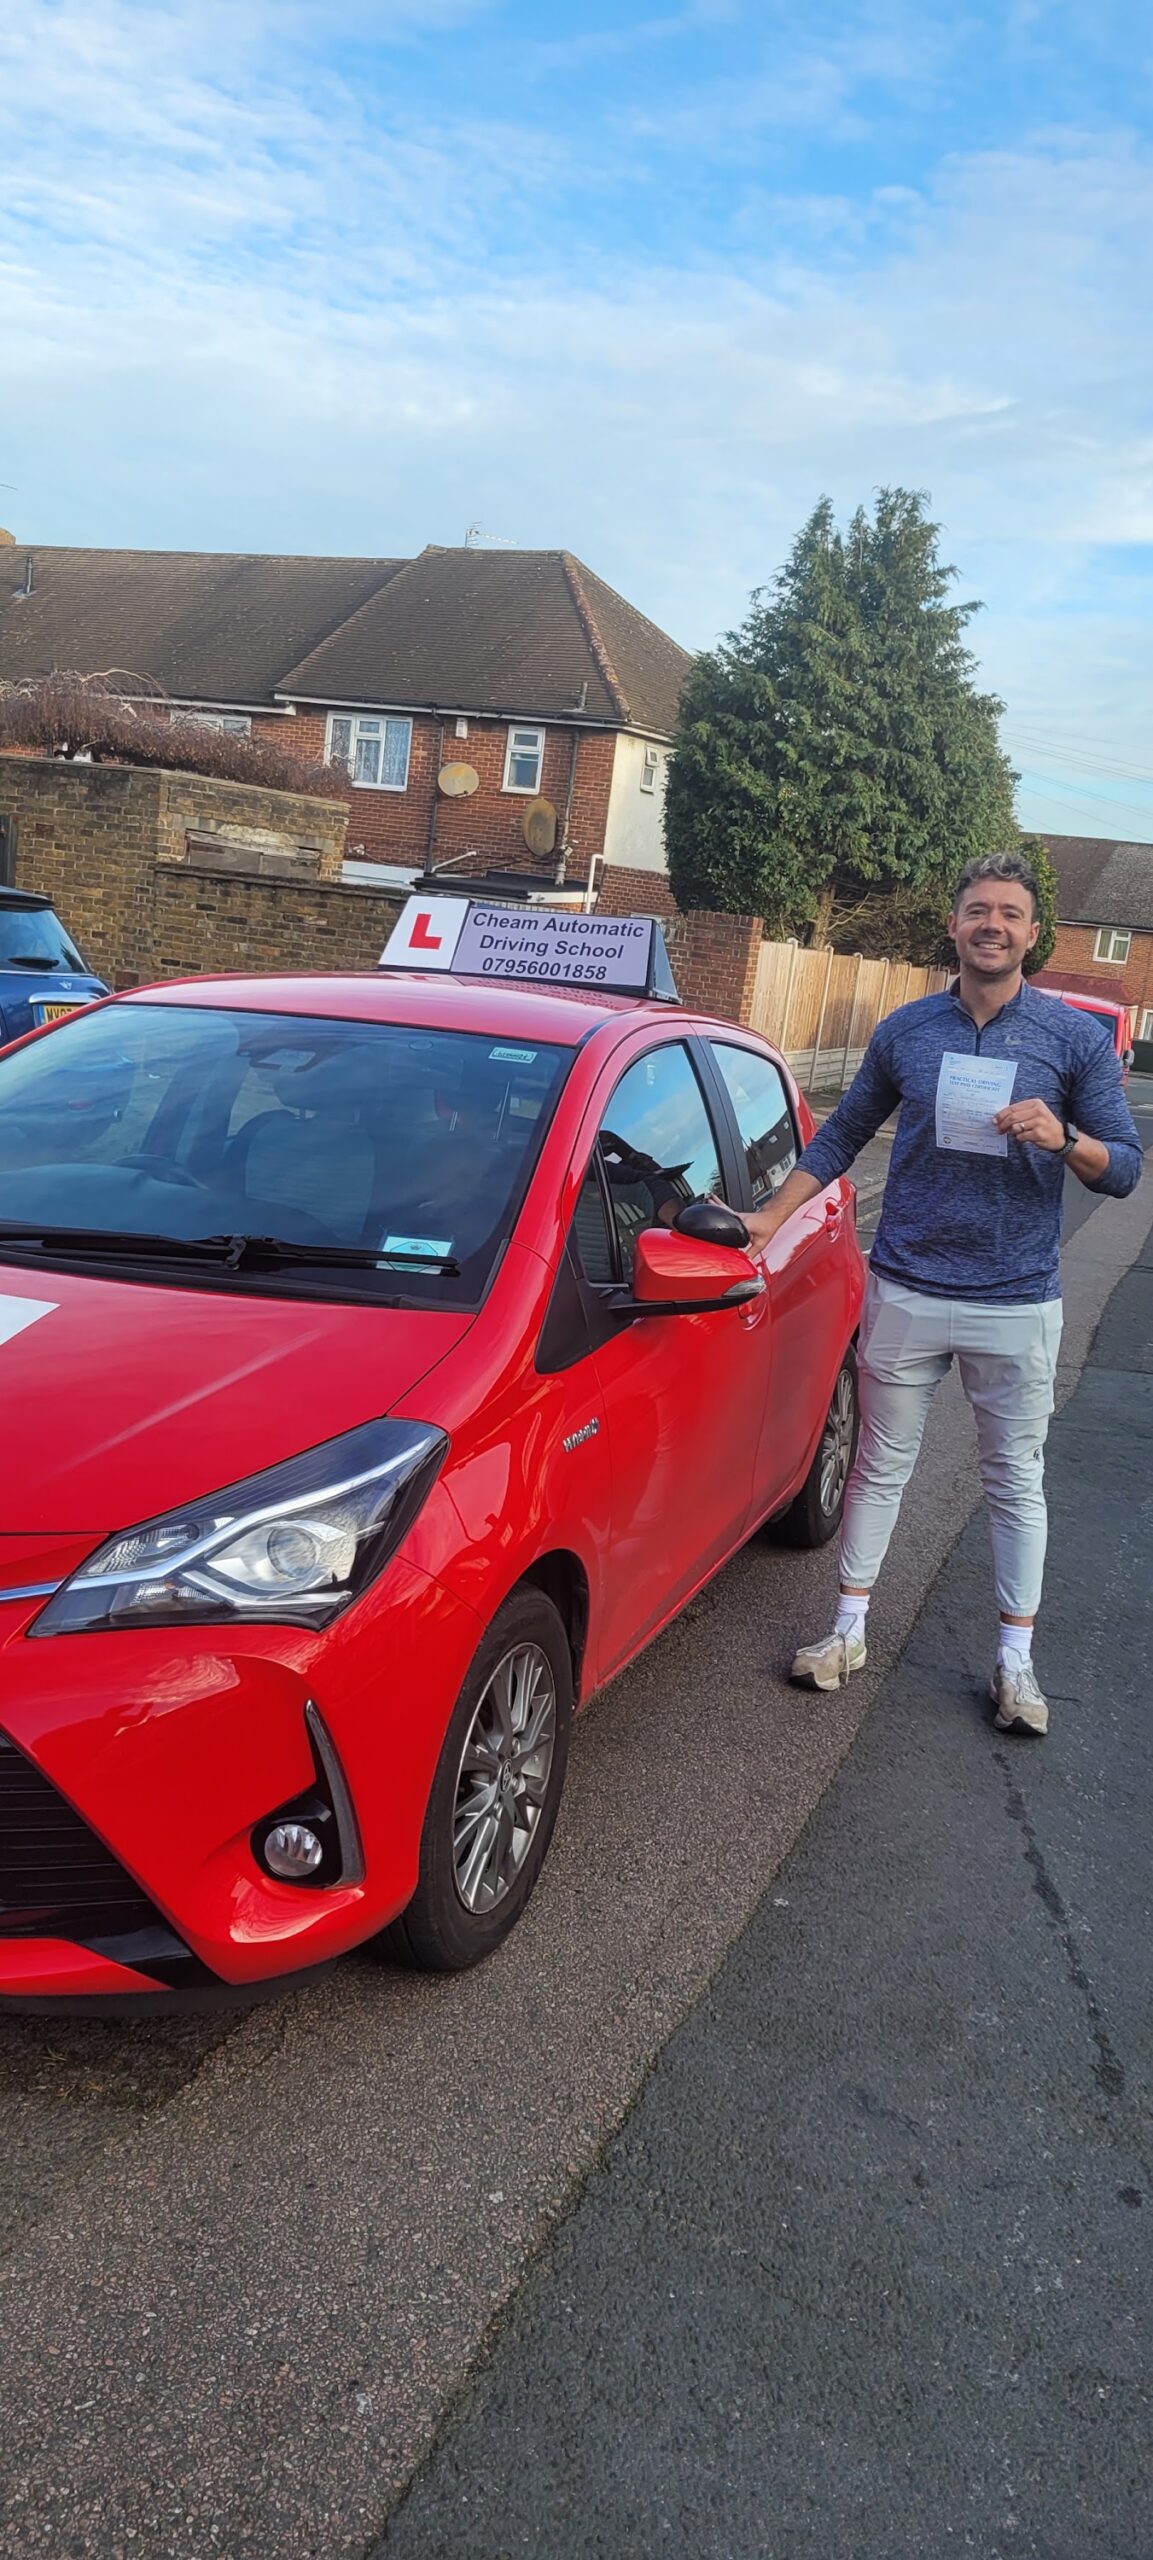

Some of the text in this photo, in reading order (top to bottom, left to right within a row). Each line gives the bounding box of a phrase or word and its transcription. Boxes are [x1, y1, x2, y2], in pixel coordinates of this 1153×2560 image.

[408, 913, 443, 950] L
[473, 912, 645, 938] Cheam Automatic
[479, 934, 624, 959] Driving School
[482, 957, 607, 980] 07956001858
